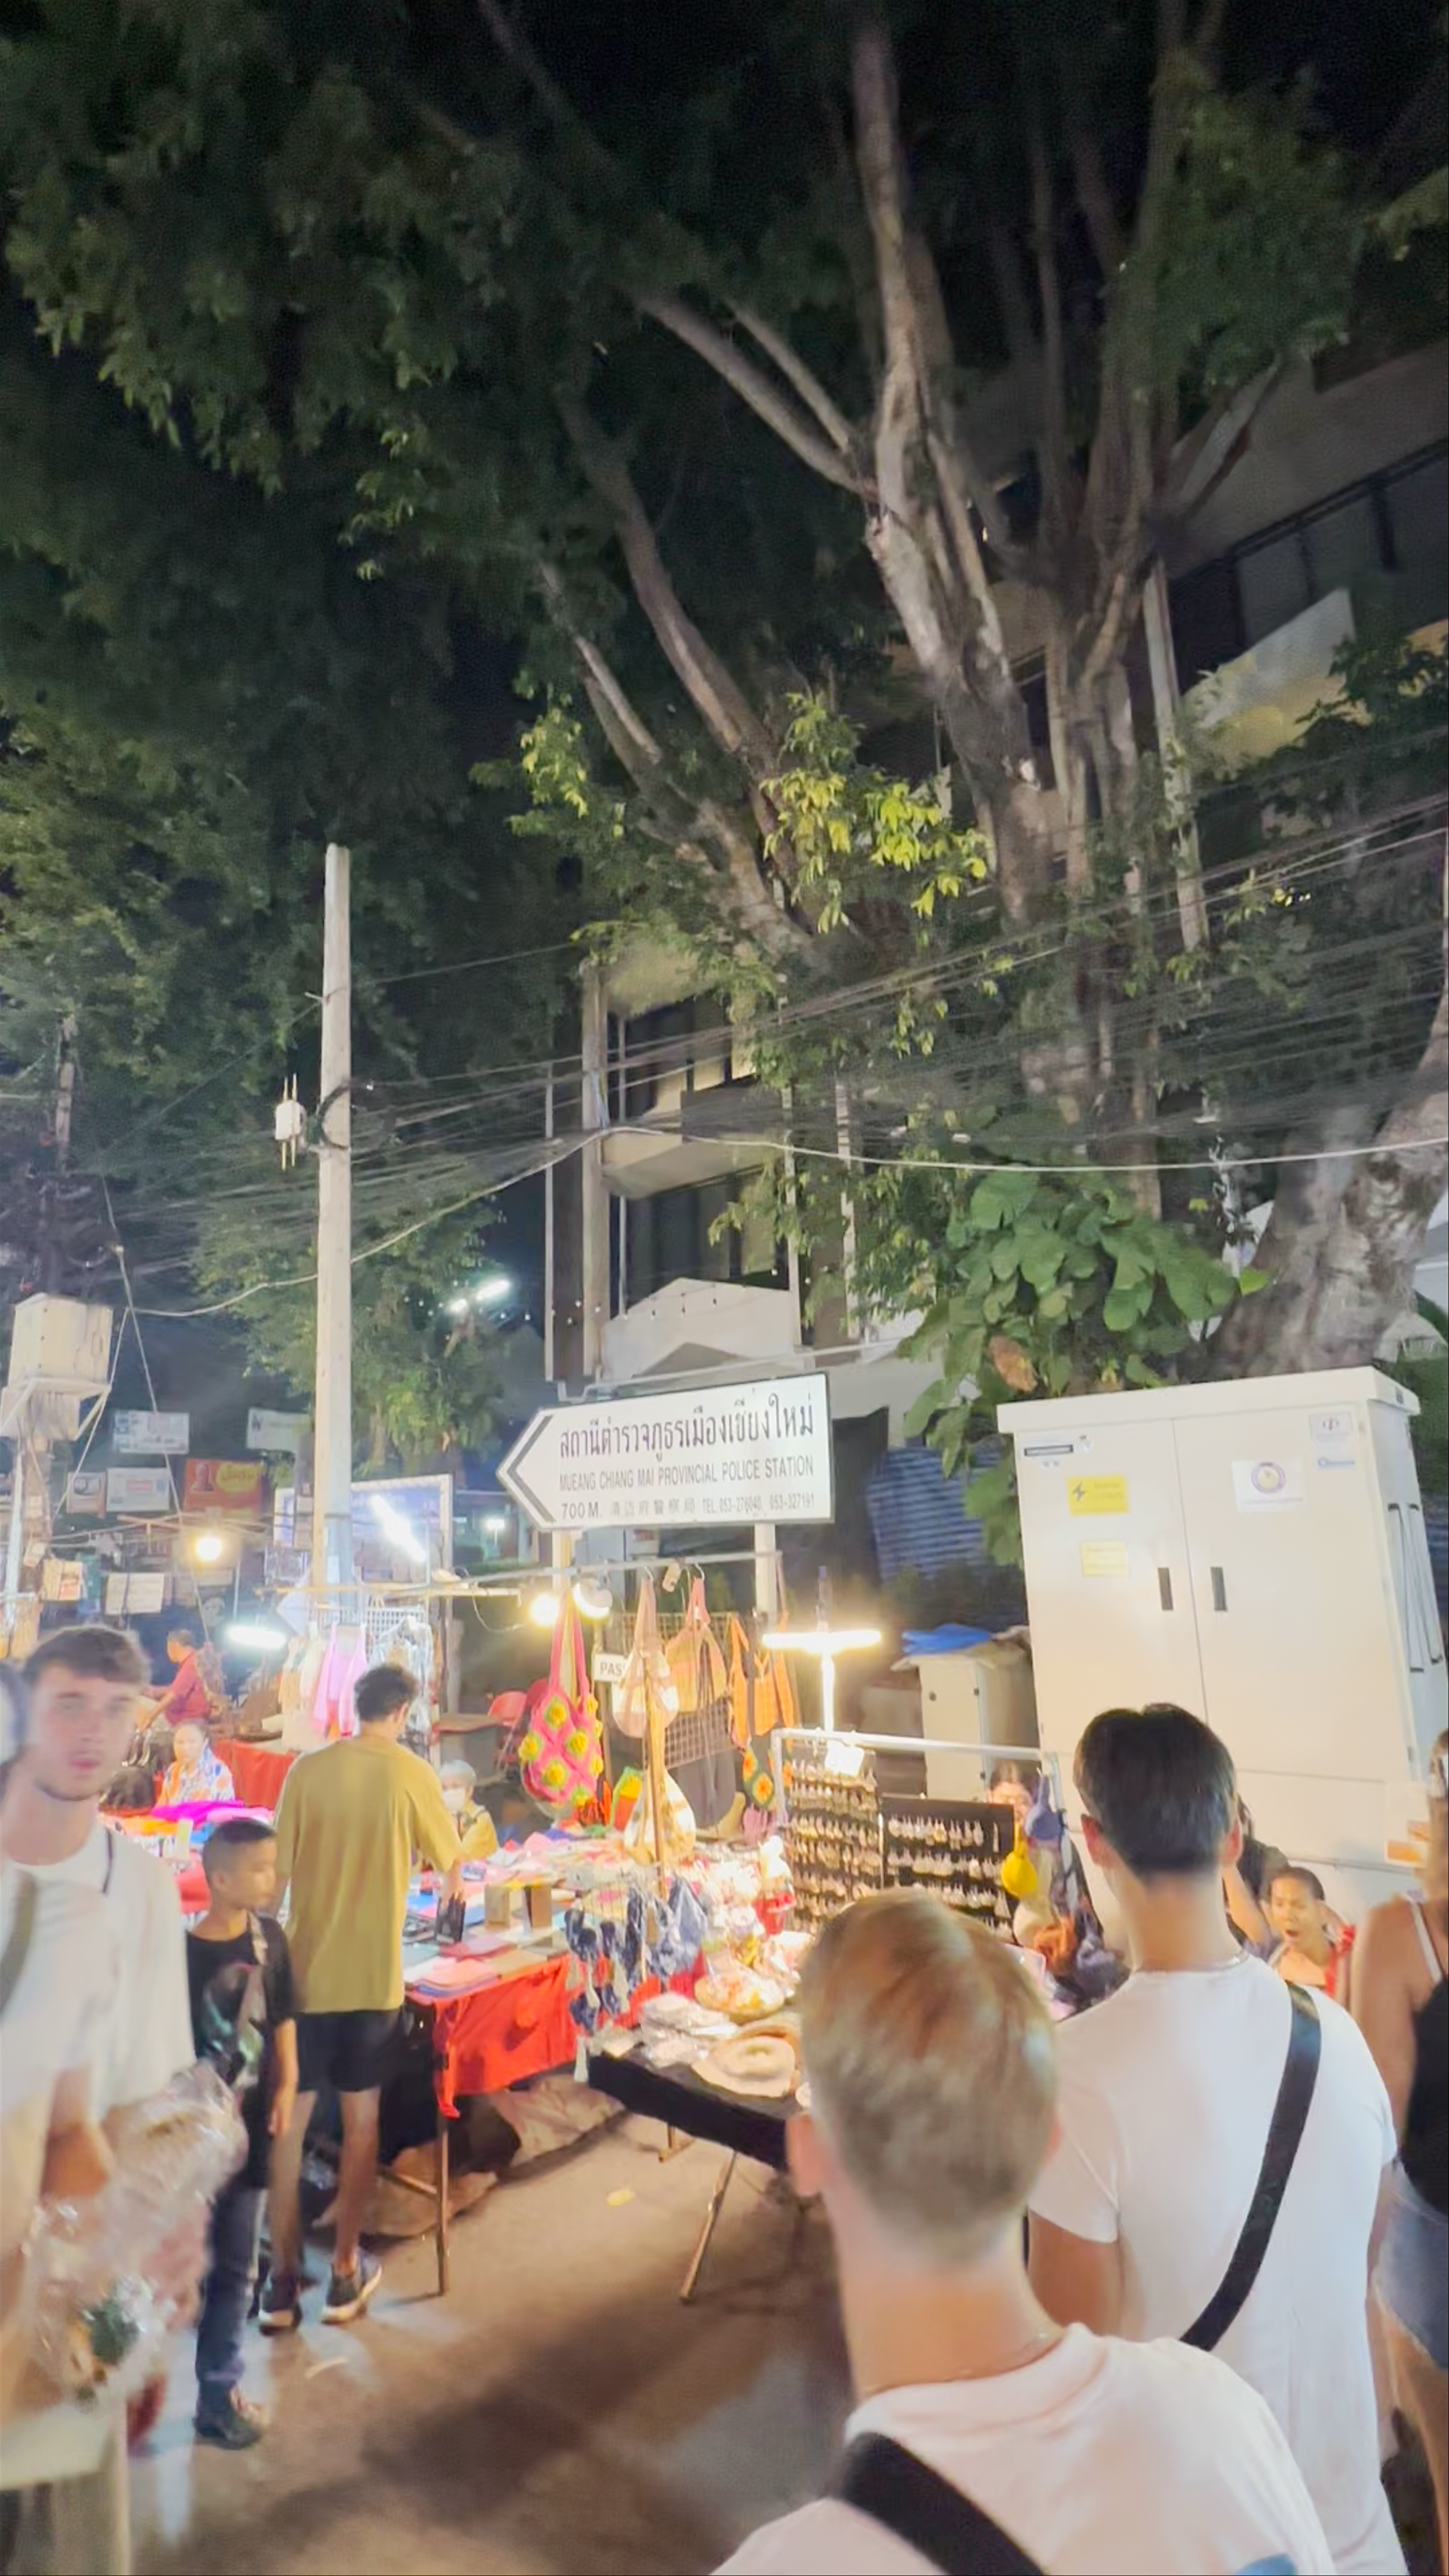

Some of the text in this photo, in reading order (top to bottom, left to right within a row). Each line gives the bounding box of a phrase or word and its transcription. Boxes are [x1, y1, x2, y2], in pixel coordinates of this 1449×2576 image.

[560, 1455, 814, 1491] MUEANG CHIANG MAI PROVINCIAL POLICE STATION
[561, 1502, 585, 1519] 700
